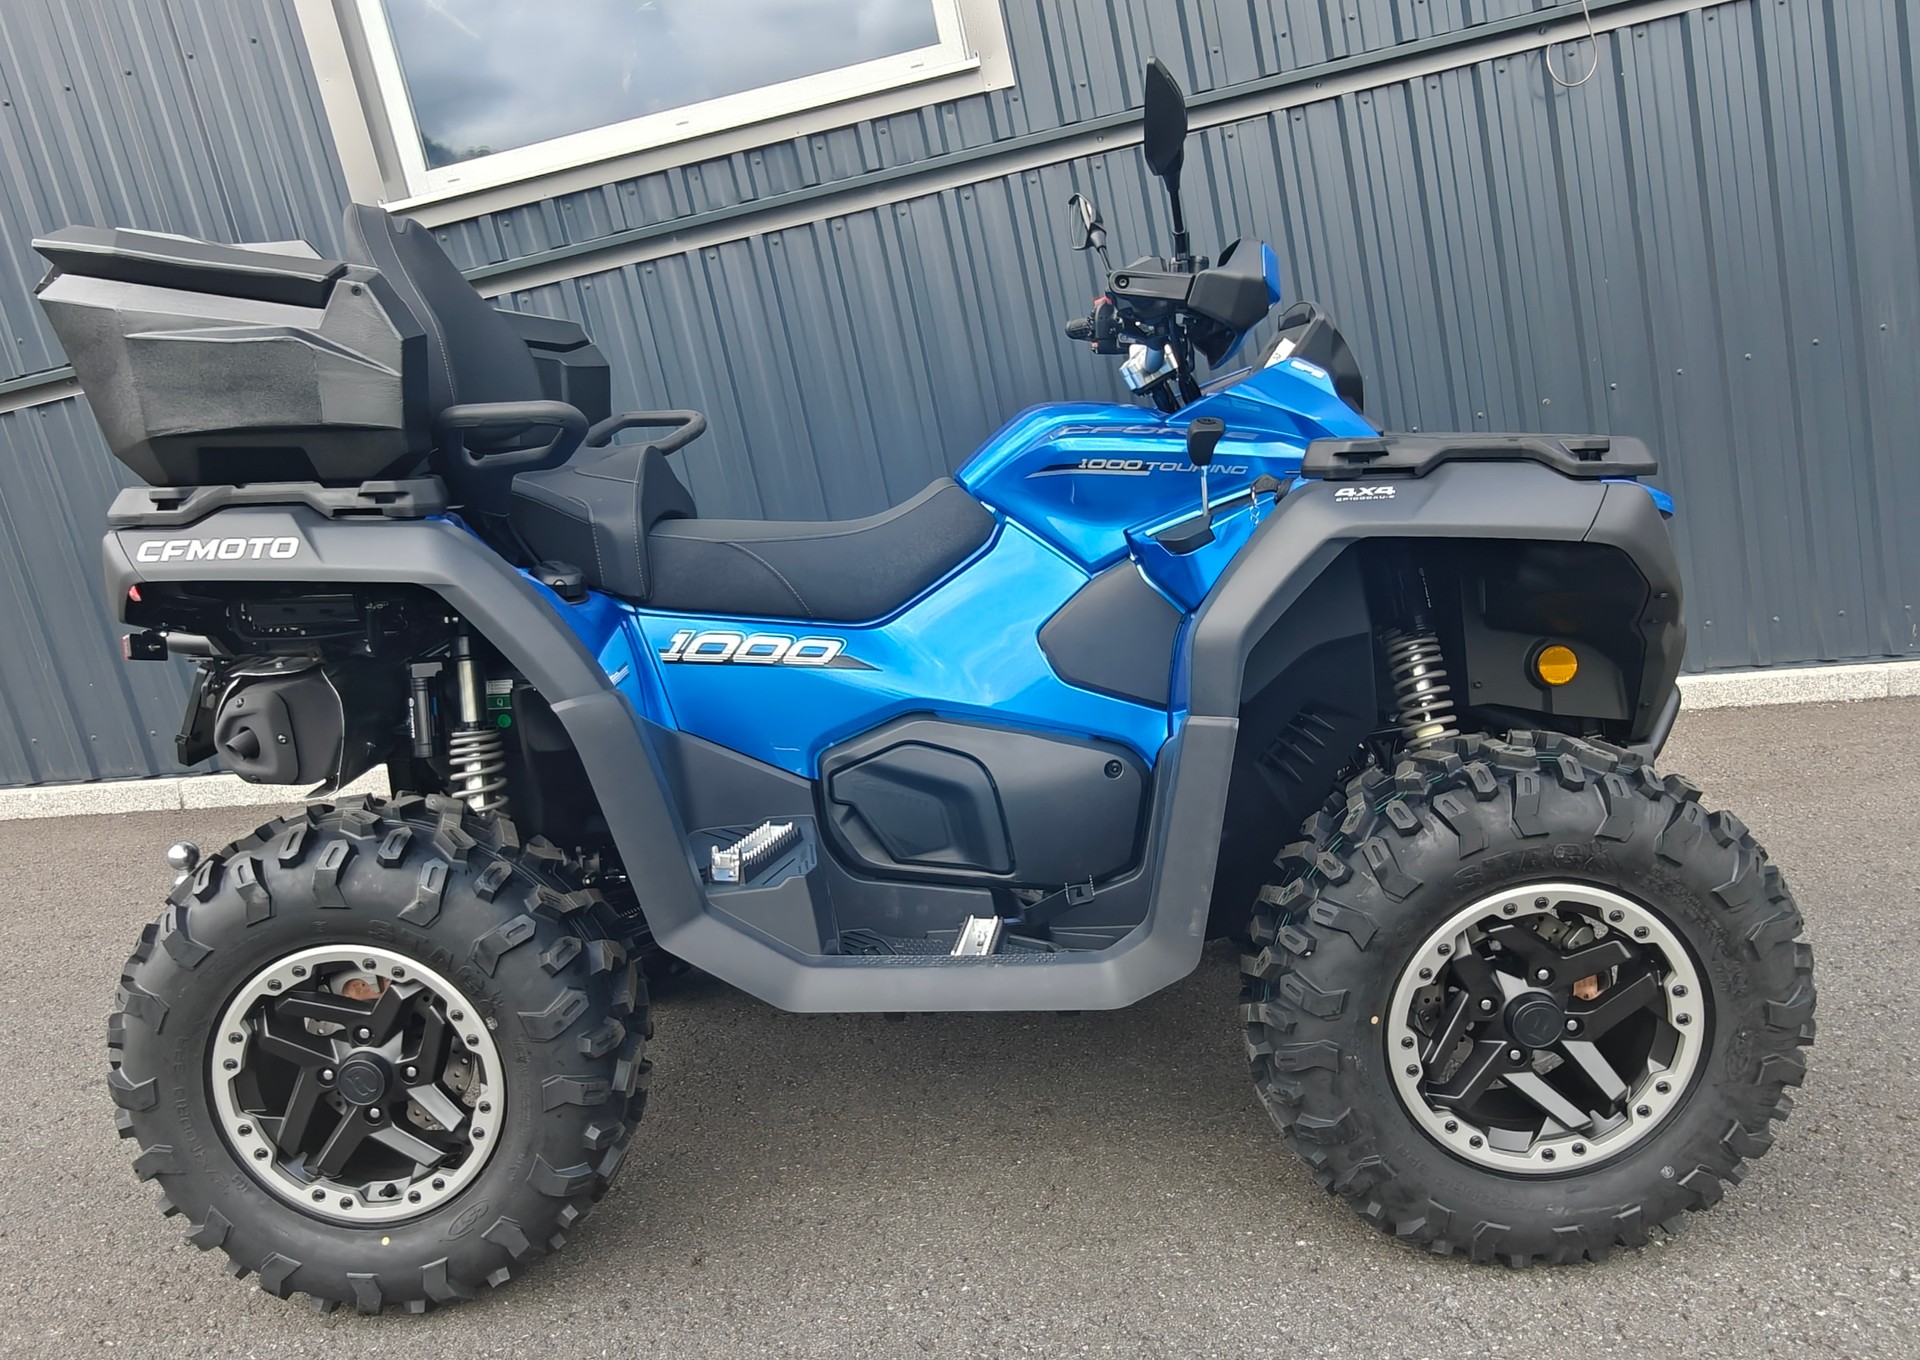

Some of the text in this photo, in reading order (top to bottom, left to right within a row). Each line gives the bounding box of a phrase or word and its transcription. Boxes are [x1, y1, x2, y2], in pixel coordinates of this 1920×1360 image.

[1078, 458, 1145, 471] 1000
[1334, 486, 1396, 497] 4X4
[136, 536, 299, 562] CFMOTO
[659, 629, 847, 665] 1000
